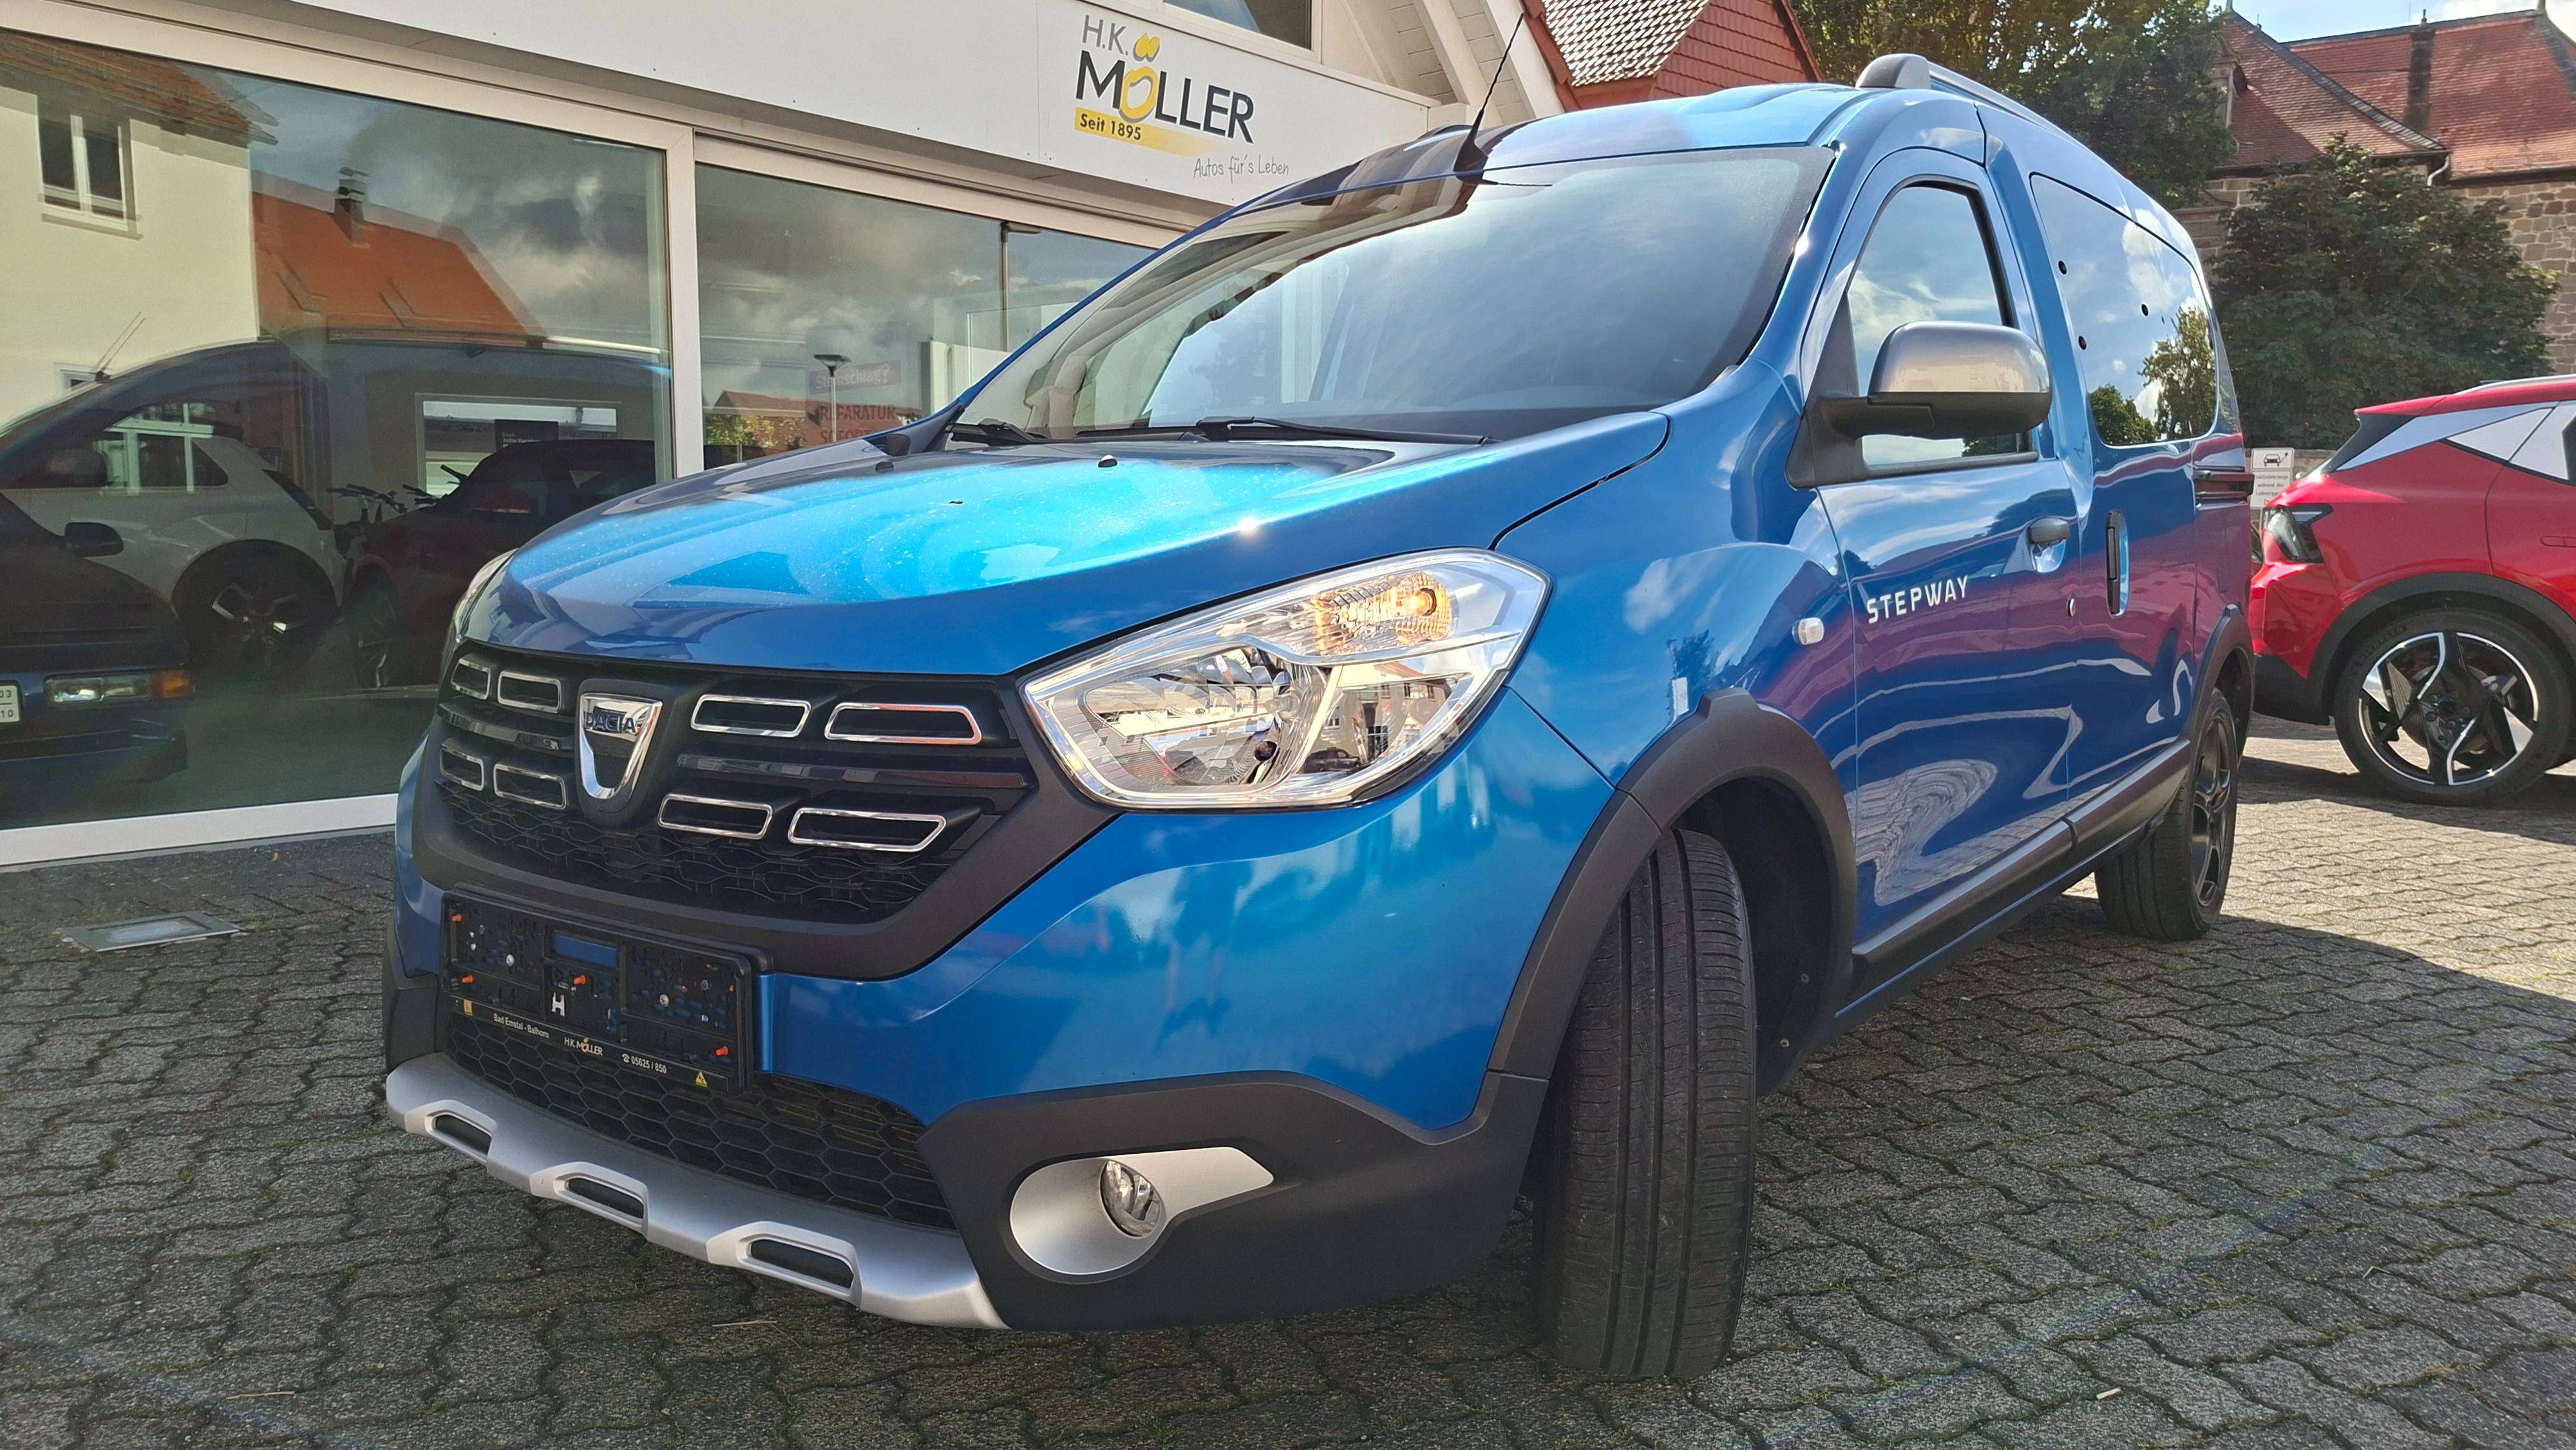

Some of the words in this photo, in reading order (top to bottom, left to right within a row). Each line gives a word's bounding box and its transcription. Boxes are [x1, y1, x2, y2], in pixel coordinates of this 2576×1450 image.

[1082, 15, 1129, 55] H.K.
[1075, 32, 1255, 144] MÖLLER
[1080, 113, 1105, 132] Seit
[1111, 120, 1142, 141] 1895
[1193, 158, 1224, 178] Autos
[1258, 154, 1289, 176] Leben
[820, 405, 896, 420] RPARATUR
[1866, 575, 1968, 624] STEPWAY
[583, 710, 636, 734] DACIA
[493, 1013, 504, 1024] Bad
